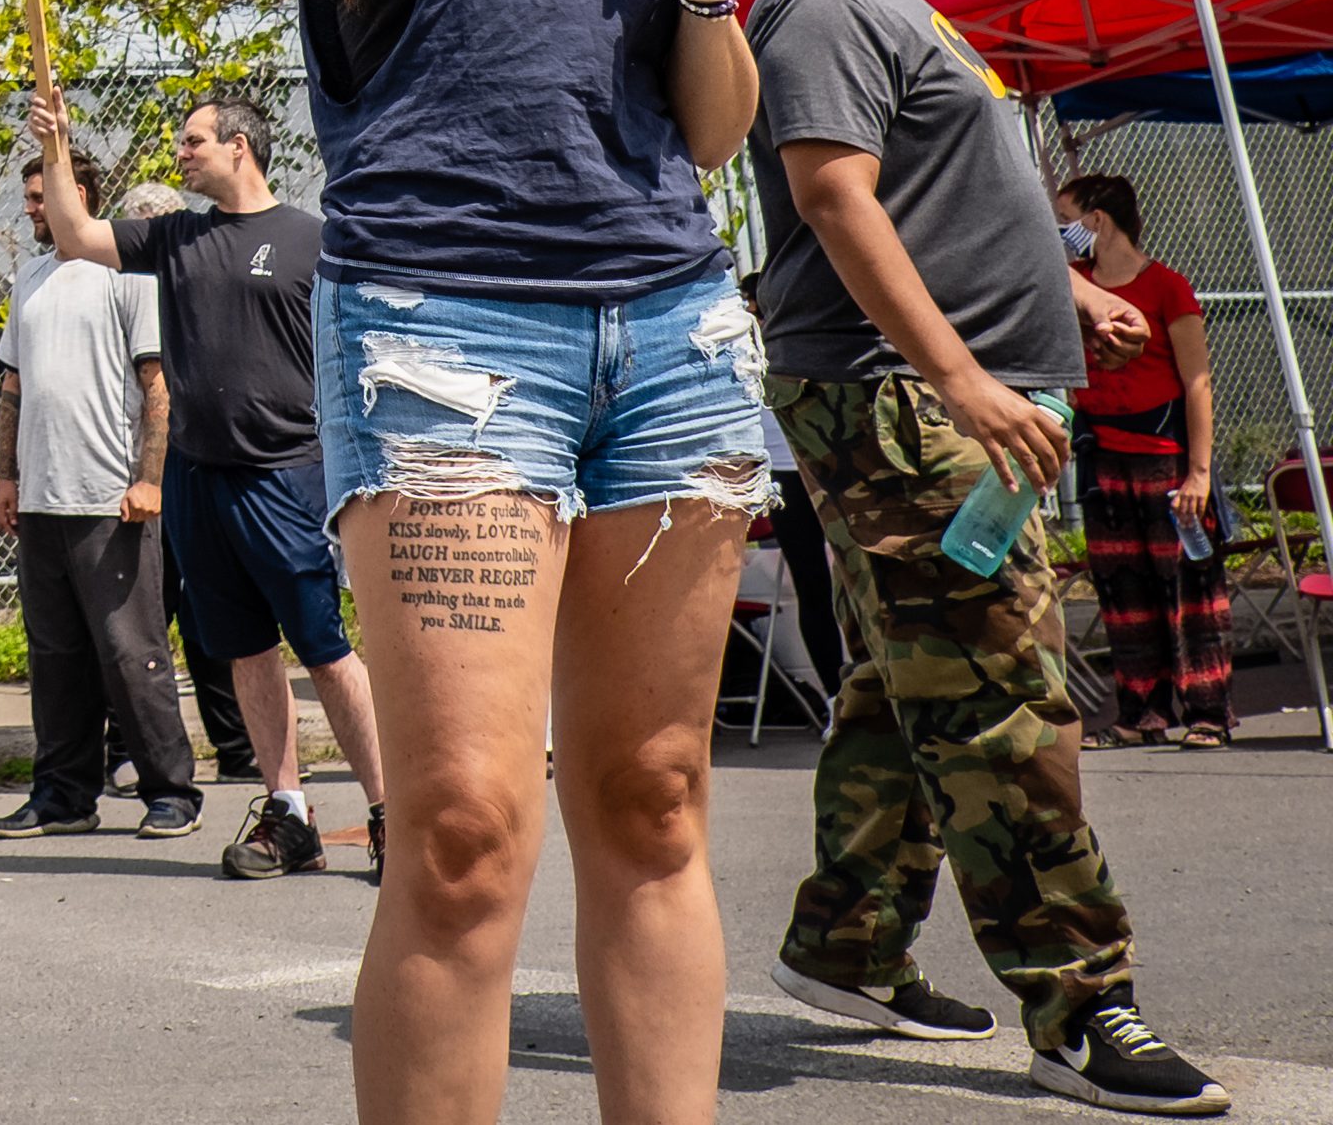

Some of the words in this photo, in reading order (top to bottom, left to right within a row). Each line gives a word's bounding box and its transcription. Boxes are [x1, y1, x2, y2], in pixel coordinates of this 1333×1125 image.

[408, 501, 487, 517] FORGIVE
[490, 504, 530, 522] quickly,
[388, 522, 422, 538] KISS
[476, 524, 519, 539] LOVE
[520, 526, 543, 543] truly,
[390, 543, 449, 561] LAUGH
[452, 548, 539, 565] uncontrollably,
[390, 567, 413, 582] and
[417, 568, 474, 584] NEVER
[479, 569, 537, 586] REGRET
[401, 590, 458, 611] anything
[462, 591, 491, 607] that
[494, 594, 526, 609] made
[420, 615, 445, 632] you
[449, 614, 506, 632] SMILE.
